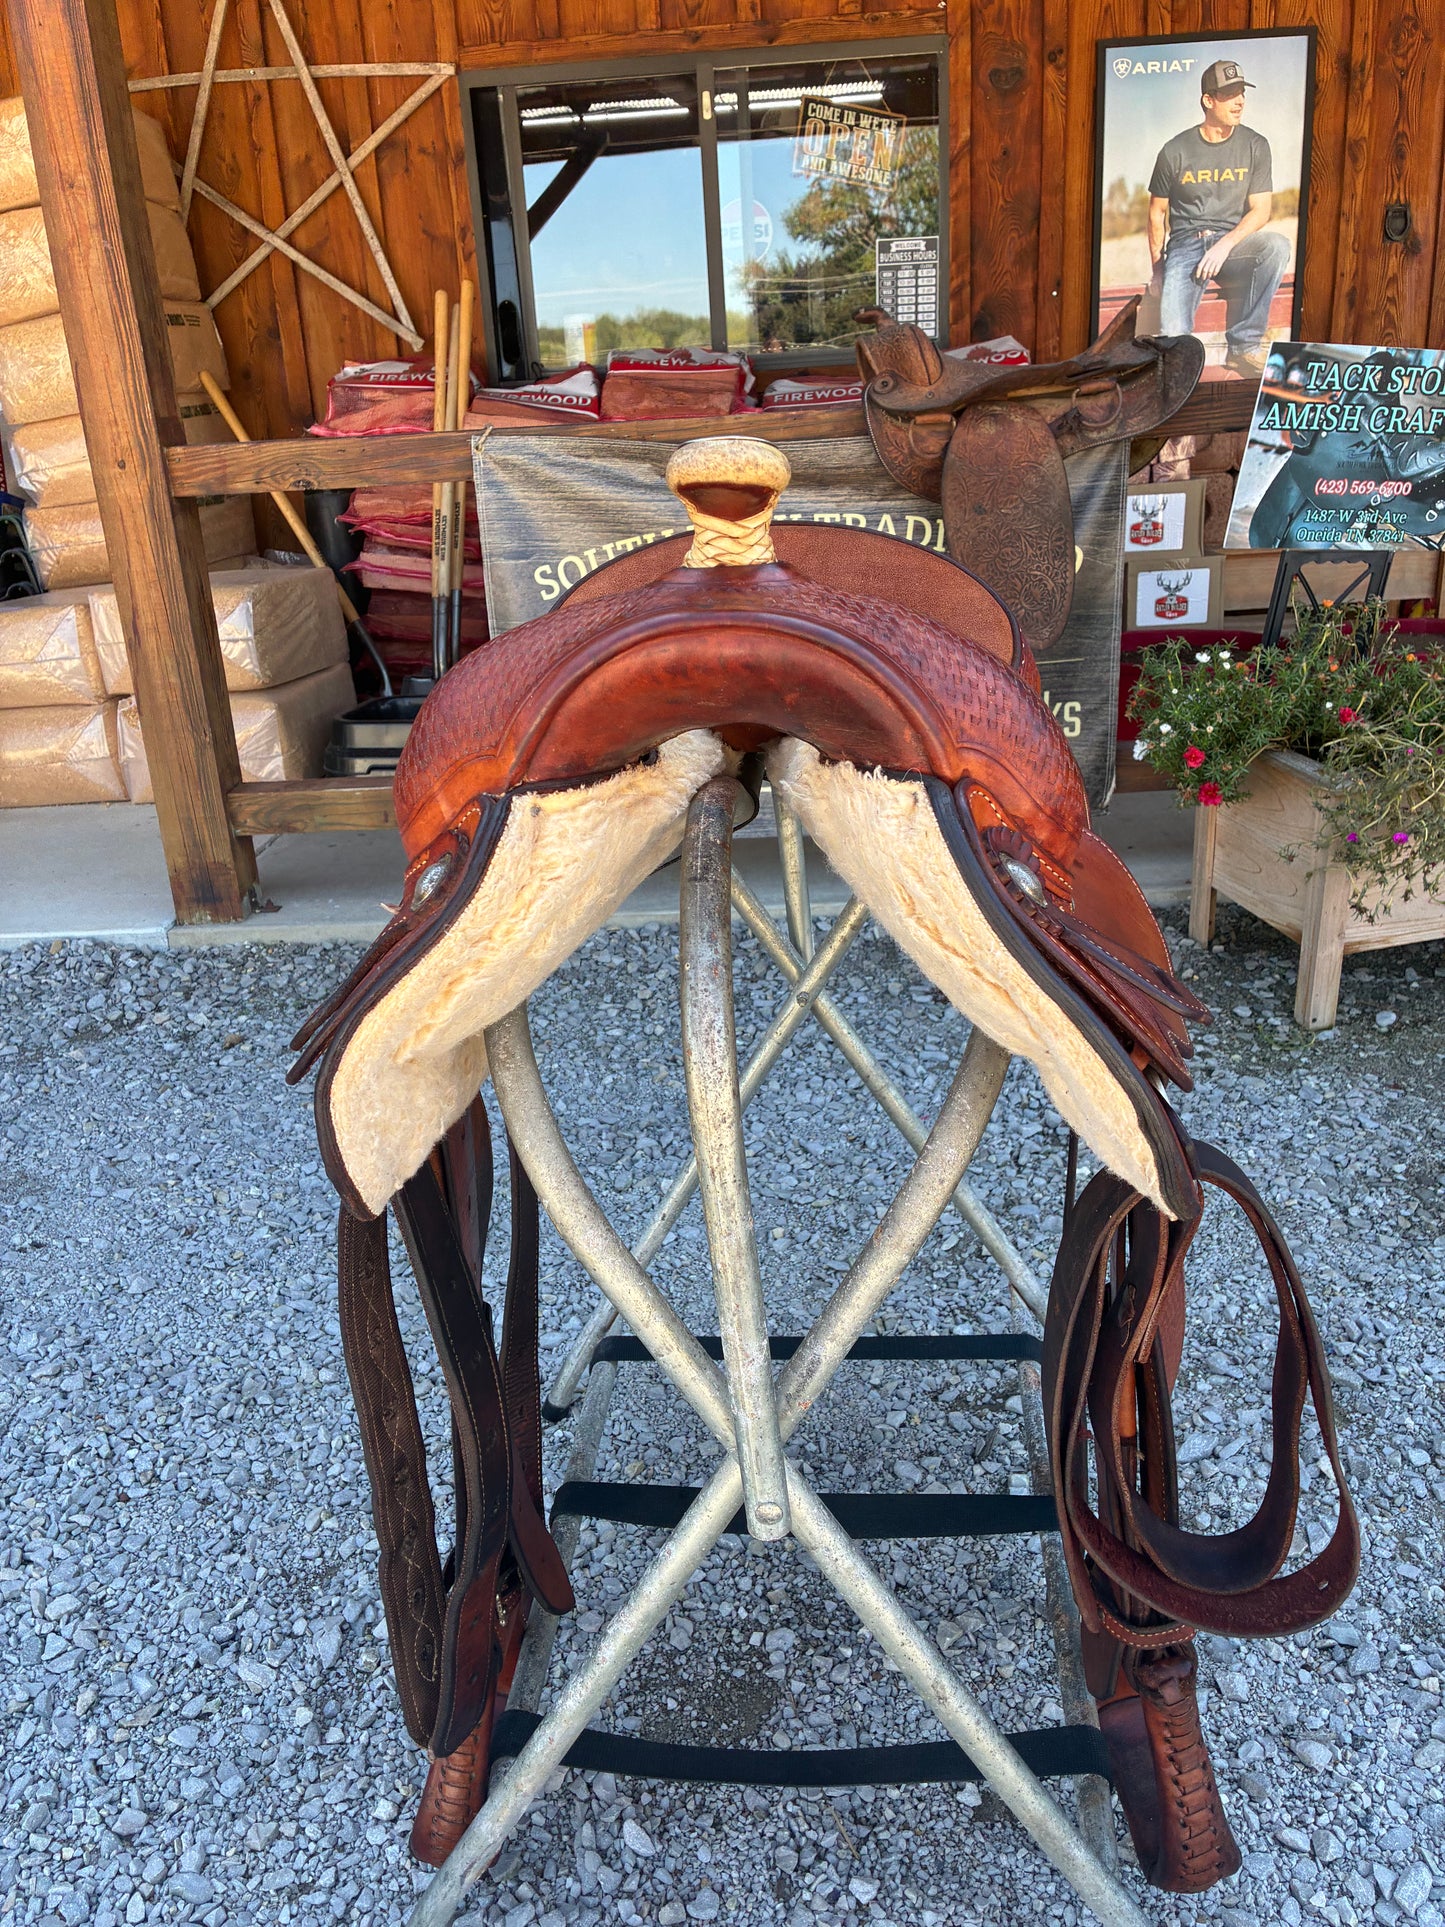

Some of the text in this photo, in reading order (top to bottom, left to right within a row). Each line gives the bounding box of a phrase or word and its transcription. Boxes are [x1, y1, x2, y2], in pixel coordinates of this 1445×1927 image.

[1132, 59, 1195, 75] ARIAT
[807, 102, 898, 134] COME IN WE'RE
[803, 117, 896, 173] OPEN
[801, 154, 892, 186] AND AWESOME
[1181, 168, 1248, 184] ARIAT
[880, 250, 937, 262] BUSINESS HOURS
[1306, 362, 1445, 396] TACK STO
[1260, 402, 1445, 435] AMISH CRAF
[1315, 478, 1413, 496] (423) 569-6700
[1304, 510, 1407, 524] 1487 W 3rd Ave
[1296, 527, 1405, 543] Oneida TN 37841
